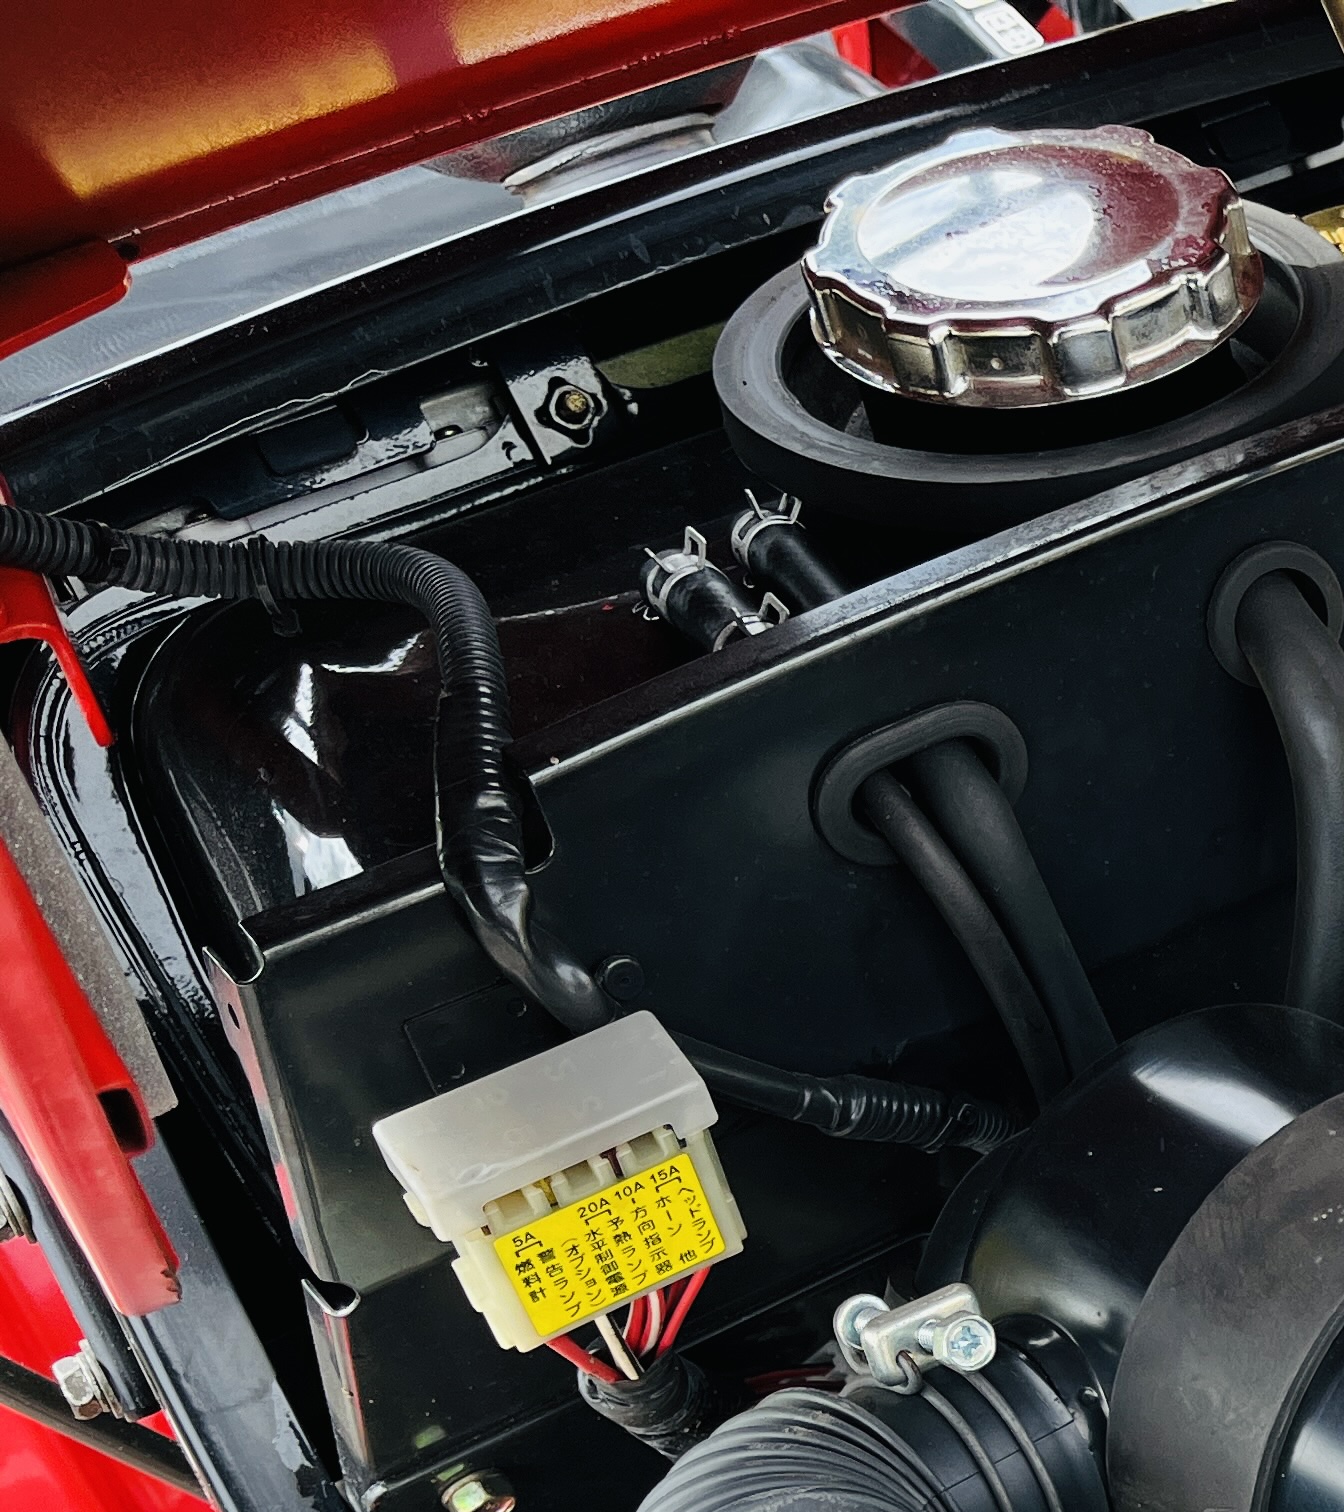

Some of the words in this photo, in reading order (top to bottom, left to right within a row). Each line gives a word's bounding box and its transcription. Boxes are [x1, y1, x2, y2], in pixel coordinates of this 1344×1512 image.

[511, 1231, 536, 1247] 5A
[576, 1197, 610, 1218] 20A
[614, 1181, 645, 1200] 10A
[649, 1165, 680, 1183] 15A
[631, 1205, 672, 1275] 方向指示器
[677, 1187, 714, 1253] ヘッドランプ
[514, 1257, 546, 1302] 燃料計
[536, 1247, 581, 1317] 警告ランプ
[584, 1227, 629, 1297] 水平制御電源
[607, 1215, 647, 1285] 予熱ランプ
